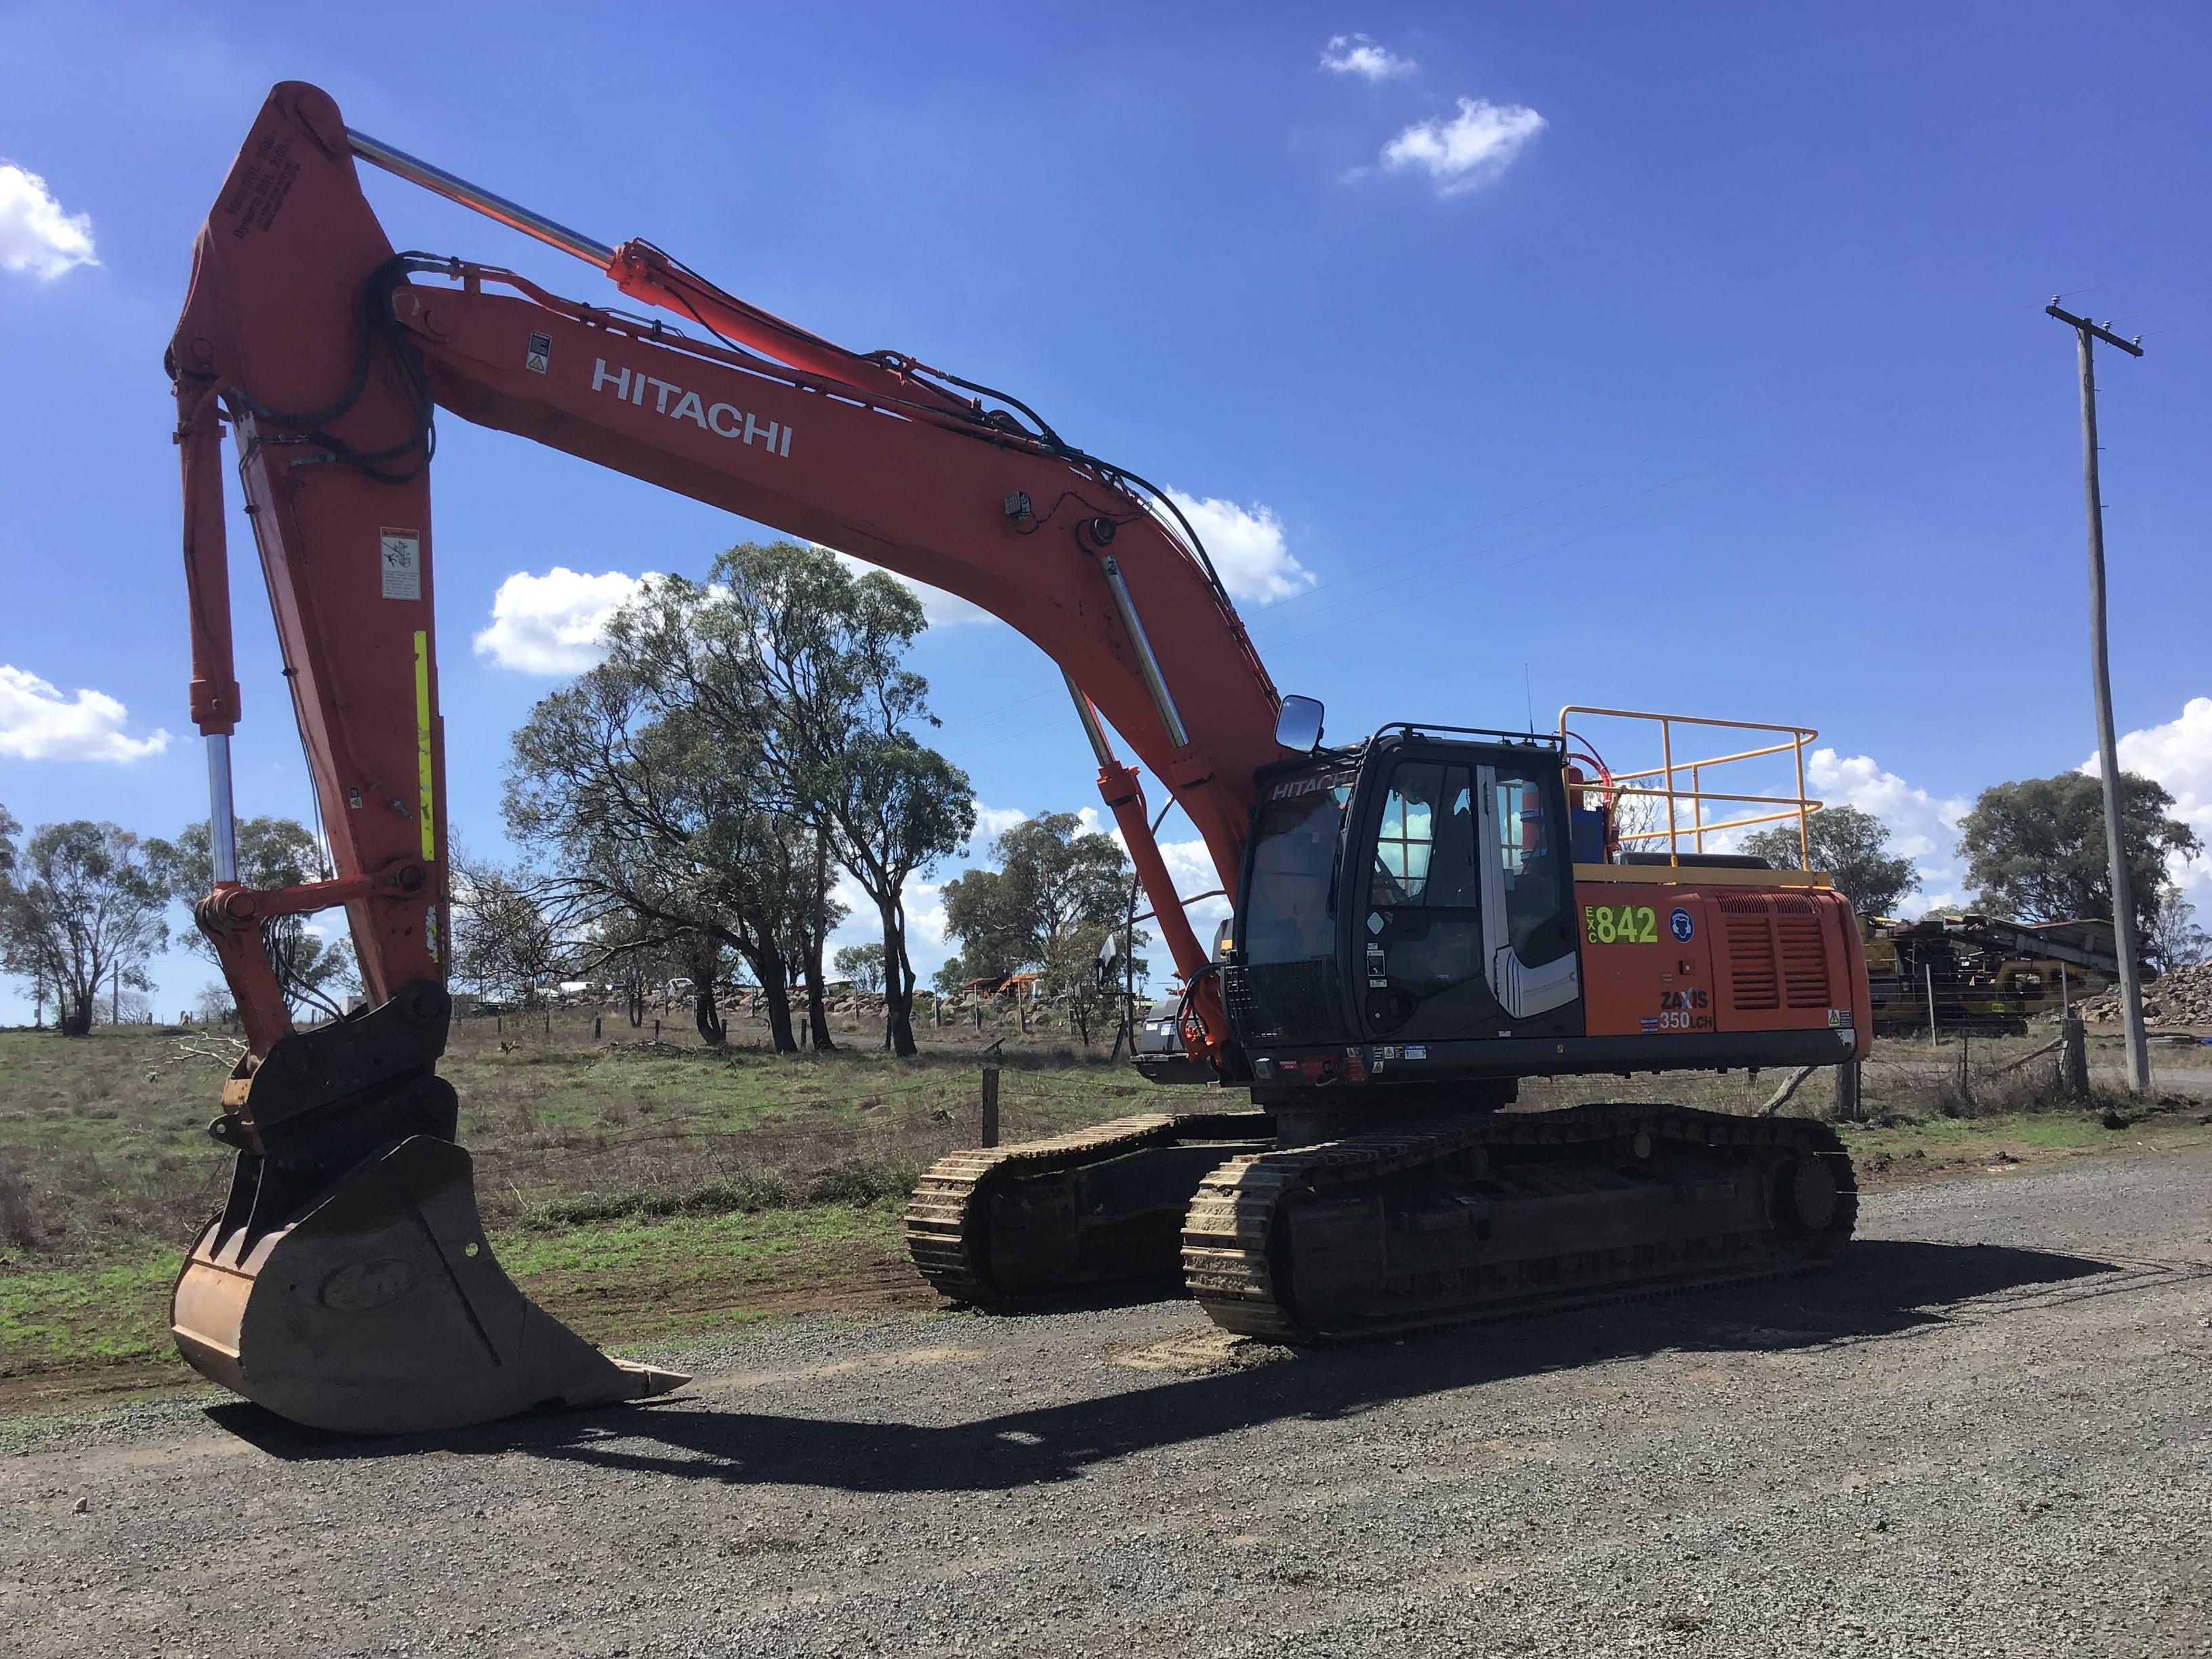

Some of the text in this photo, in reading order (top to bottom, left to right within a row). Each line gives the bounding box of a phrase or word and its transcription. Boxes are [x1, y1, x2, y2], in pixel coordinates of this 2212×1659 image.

[592, 358, 792, 458] HITACHI
[1585, 906, 1658, 943] EXC 842
[1661, 987, 1708, 1009] ZAXIS
